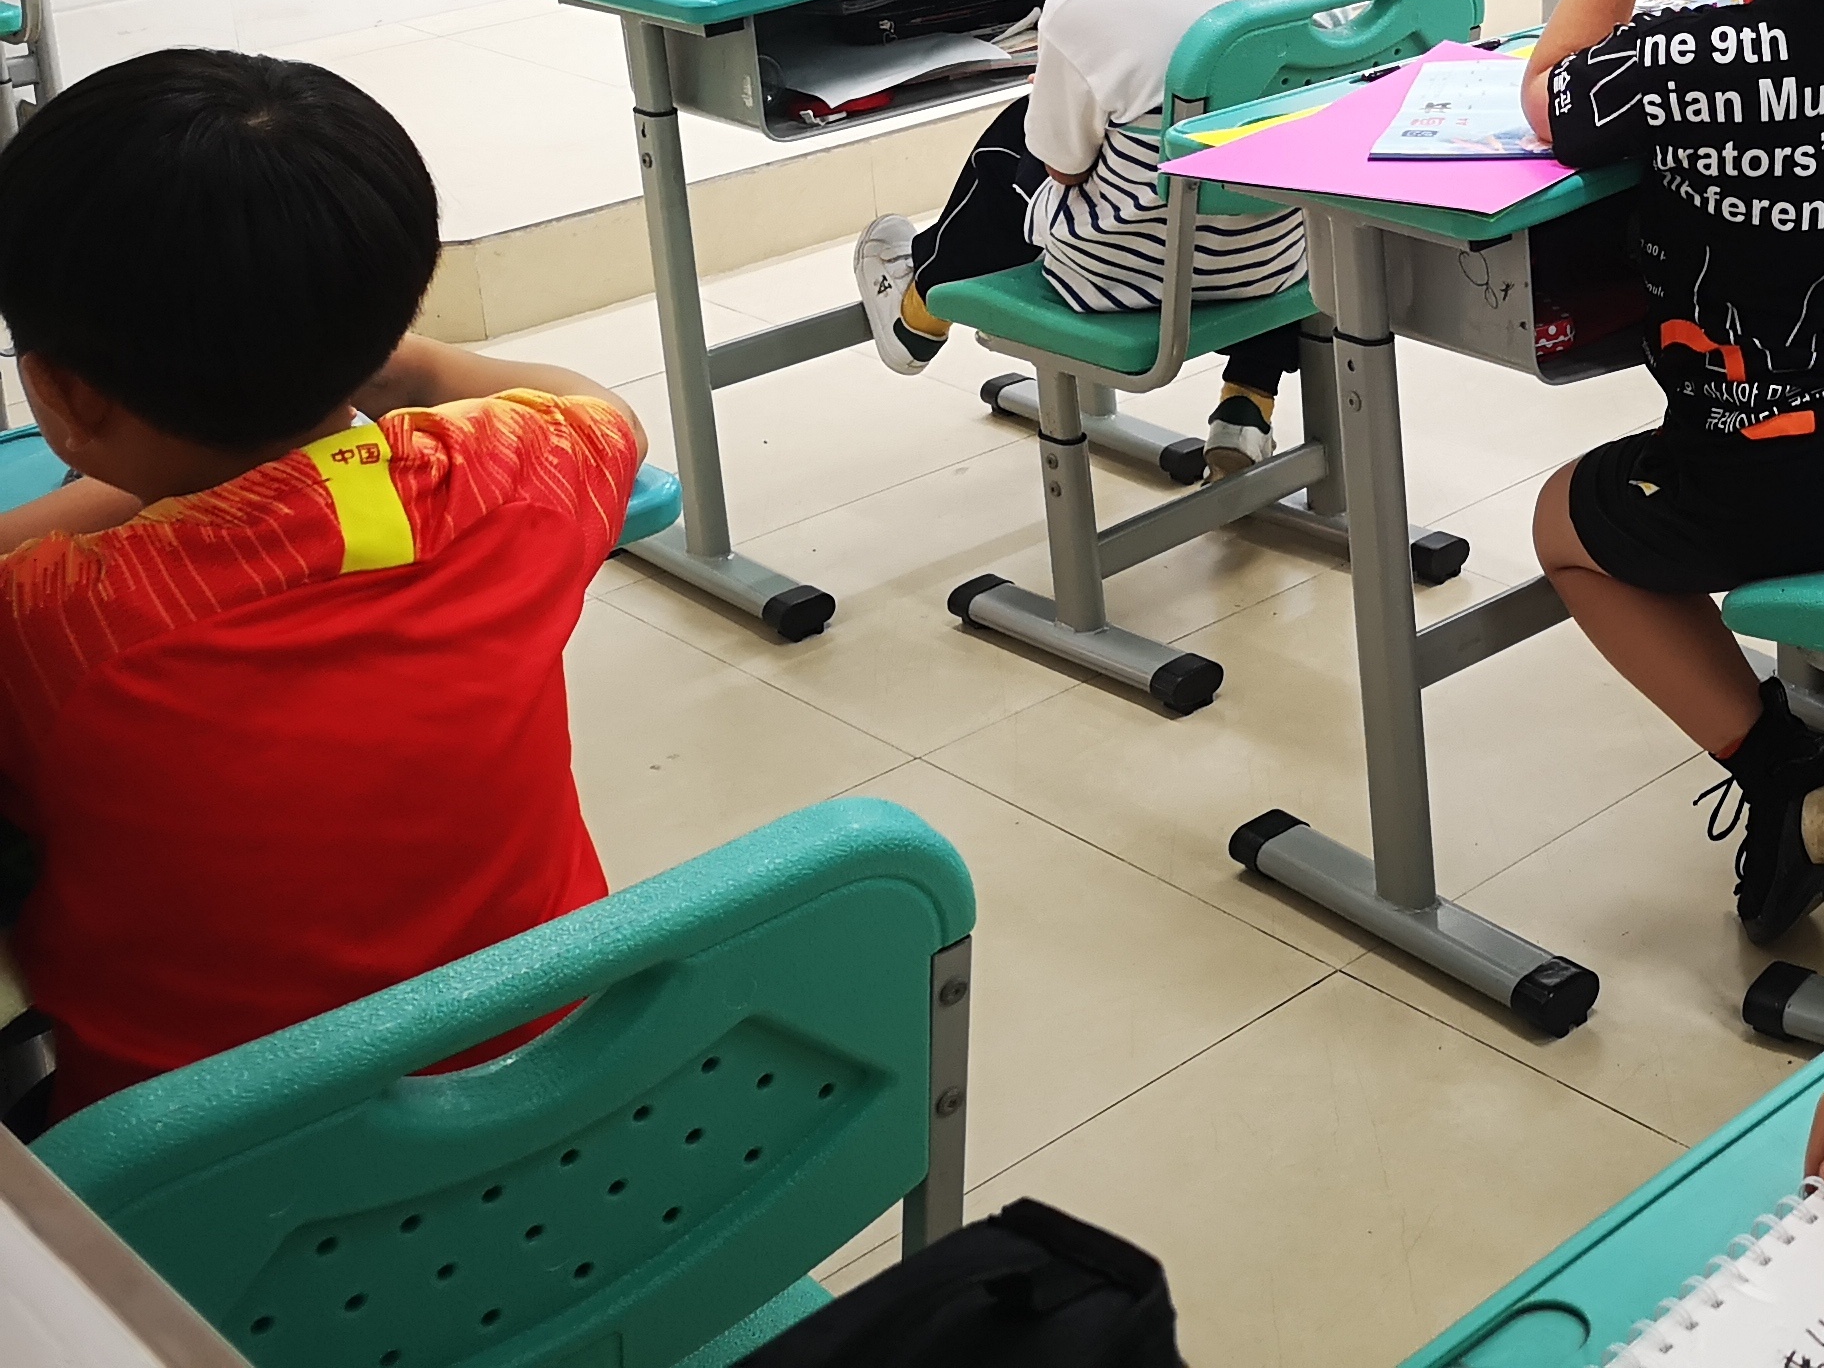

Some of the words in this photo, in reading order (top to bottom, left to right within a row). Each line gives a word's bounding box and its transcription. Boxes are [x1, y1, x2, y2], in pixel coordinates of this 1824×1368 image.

[1711, 21, 1789, 64] 9th
[1642, 81, 1743, 126] sian
[331, 443, 381, 465] 中国
